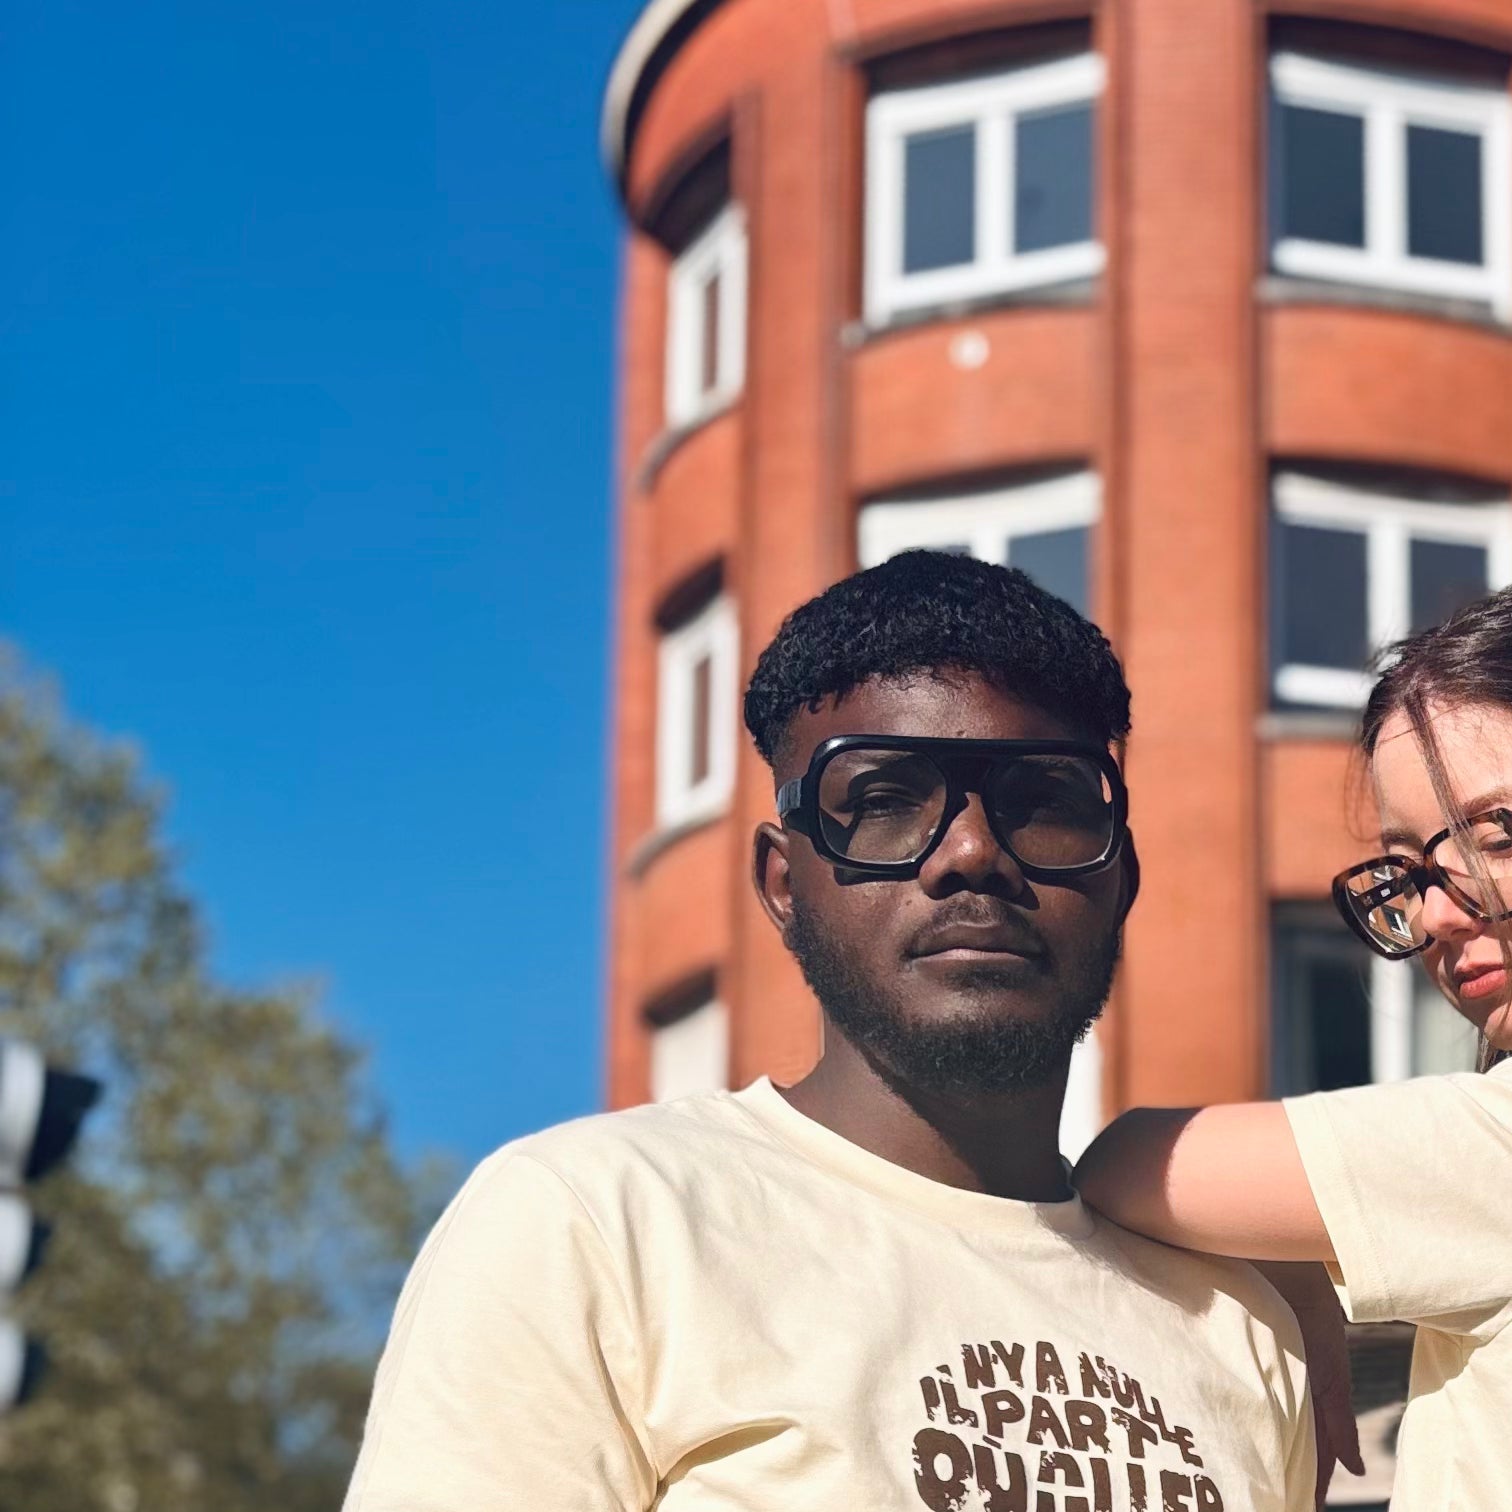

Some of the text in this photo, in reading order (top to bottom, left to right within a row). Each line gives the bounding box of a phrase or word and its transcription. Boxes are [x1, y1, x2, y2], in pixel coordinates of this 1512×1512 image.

[919, 1364, 979, 1429] IL
[1036, 1340, 1070, 1396] A
[1078, 1351, 1204, 1469] NULLE
[980, 1389, 1159, 1459] PART
